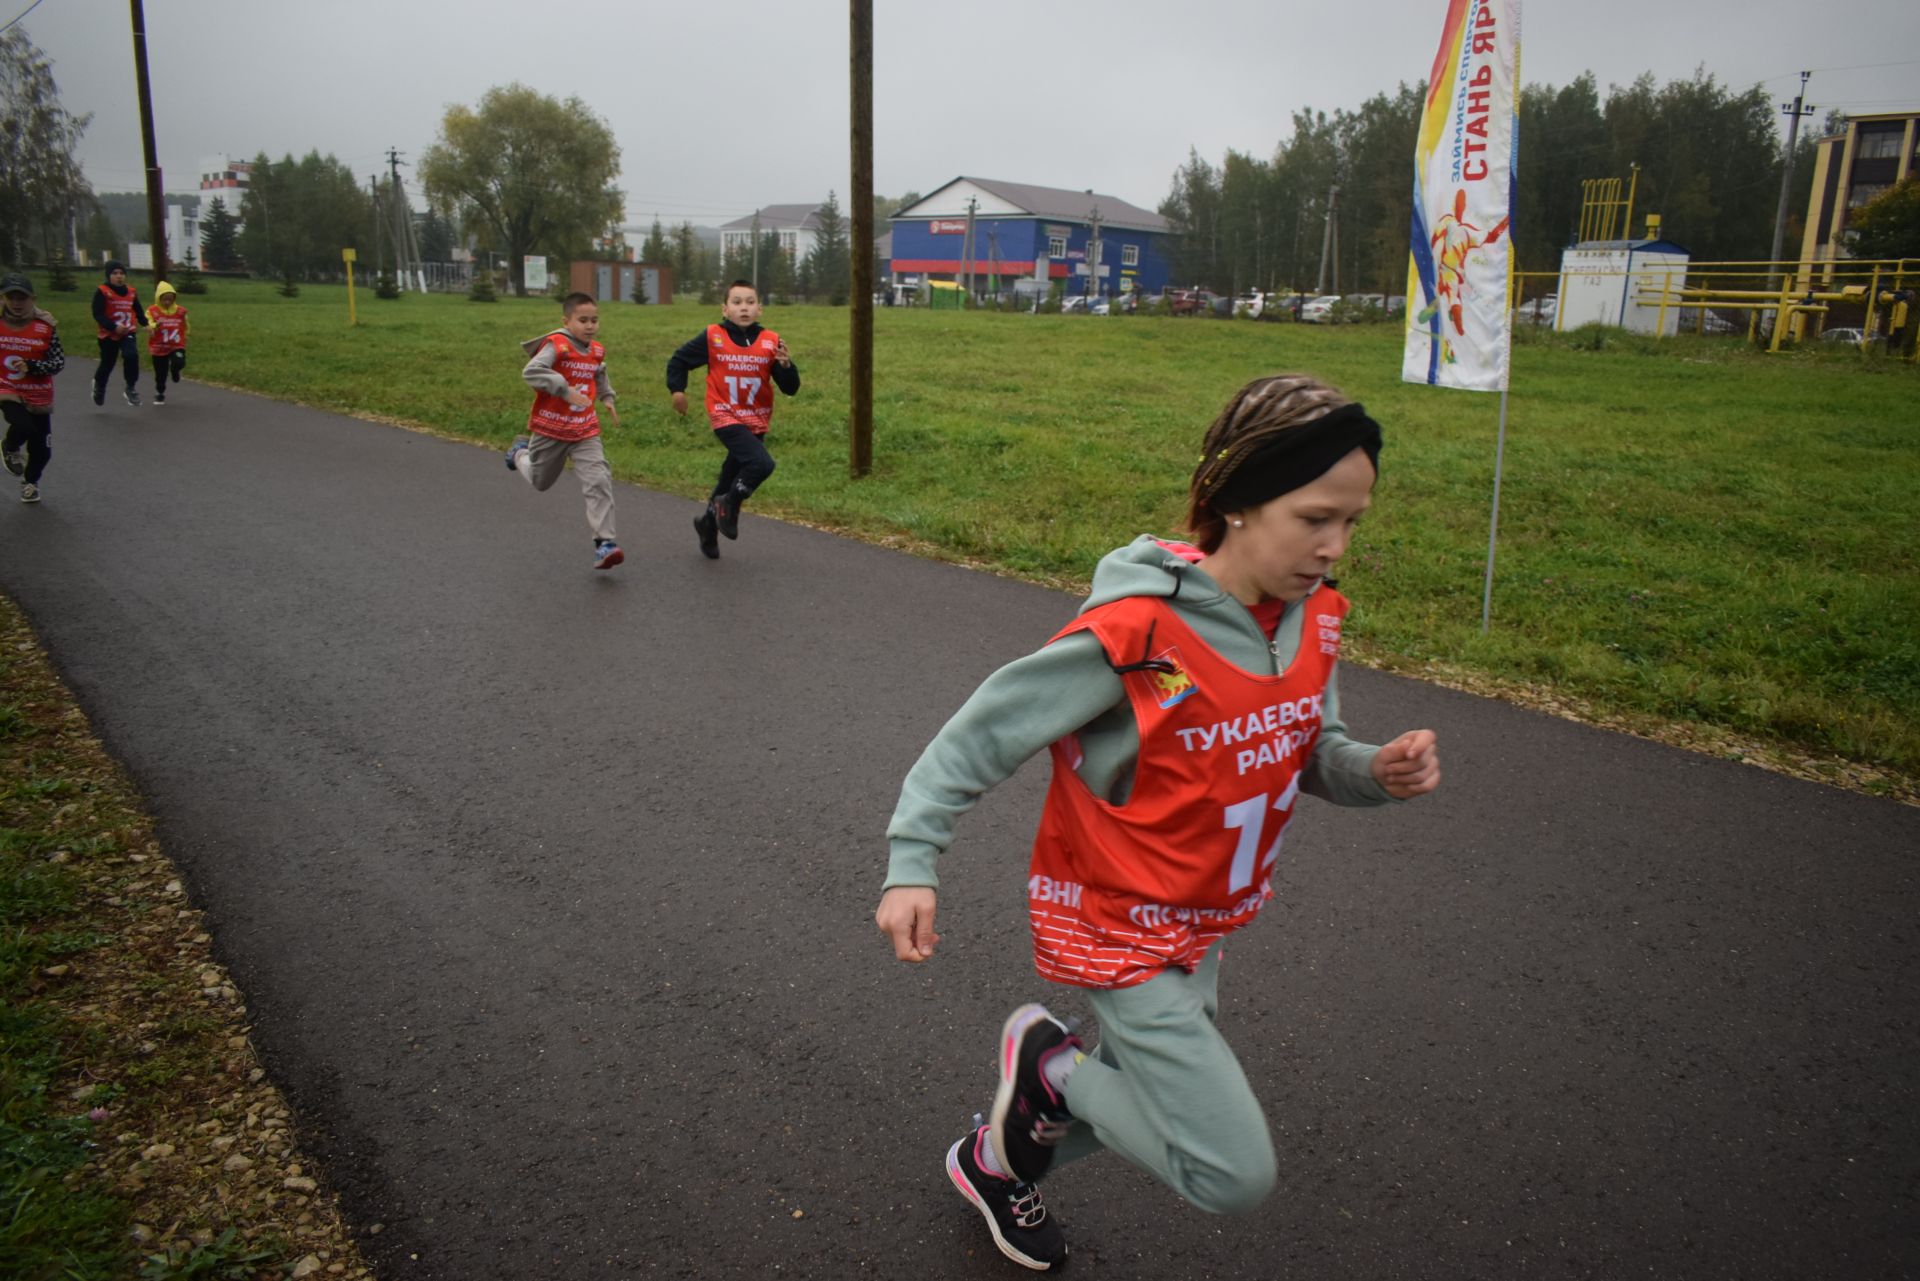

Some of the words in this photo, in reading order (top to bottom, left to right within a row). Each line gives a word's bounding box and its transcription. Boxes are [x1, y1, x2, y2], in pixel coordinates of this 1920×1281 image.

[1472, 0, 1496, 55] ЯР
[1451, 86, 1467, 183] ЗАЙМИСЬ
[1460, 0, 1479, 81] СПОРТО
[1463, 65, 1492, 182] СТАНЬ
[723, 375, 762, 406] 17
[728, 361, 760, 372] РАЙОН
